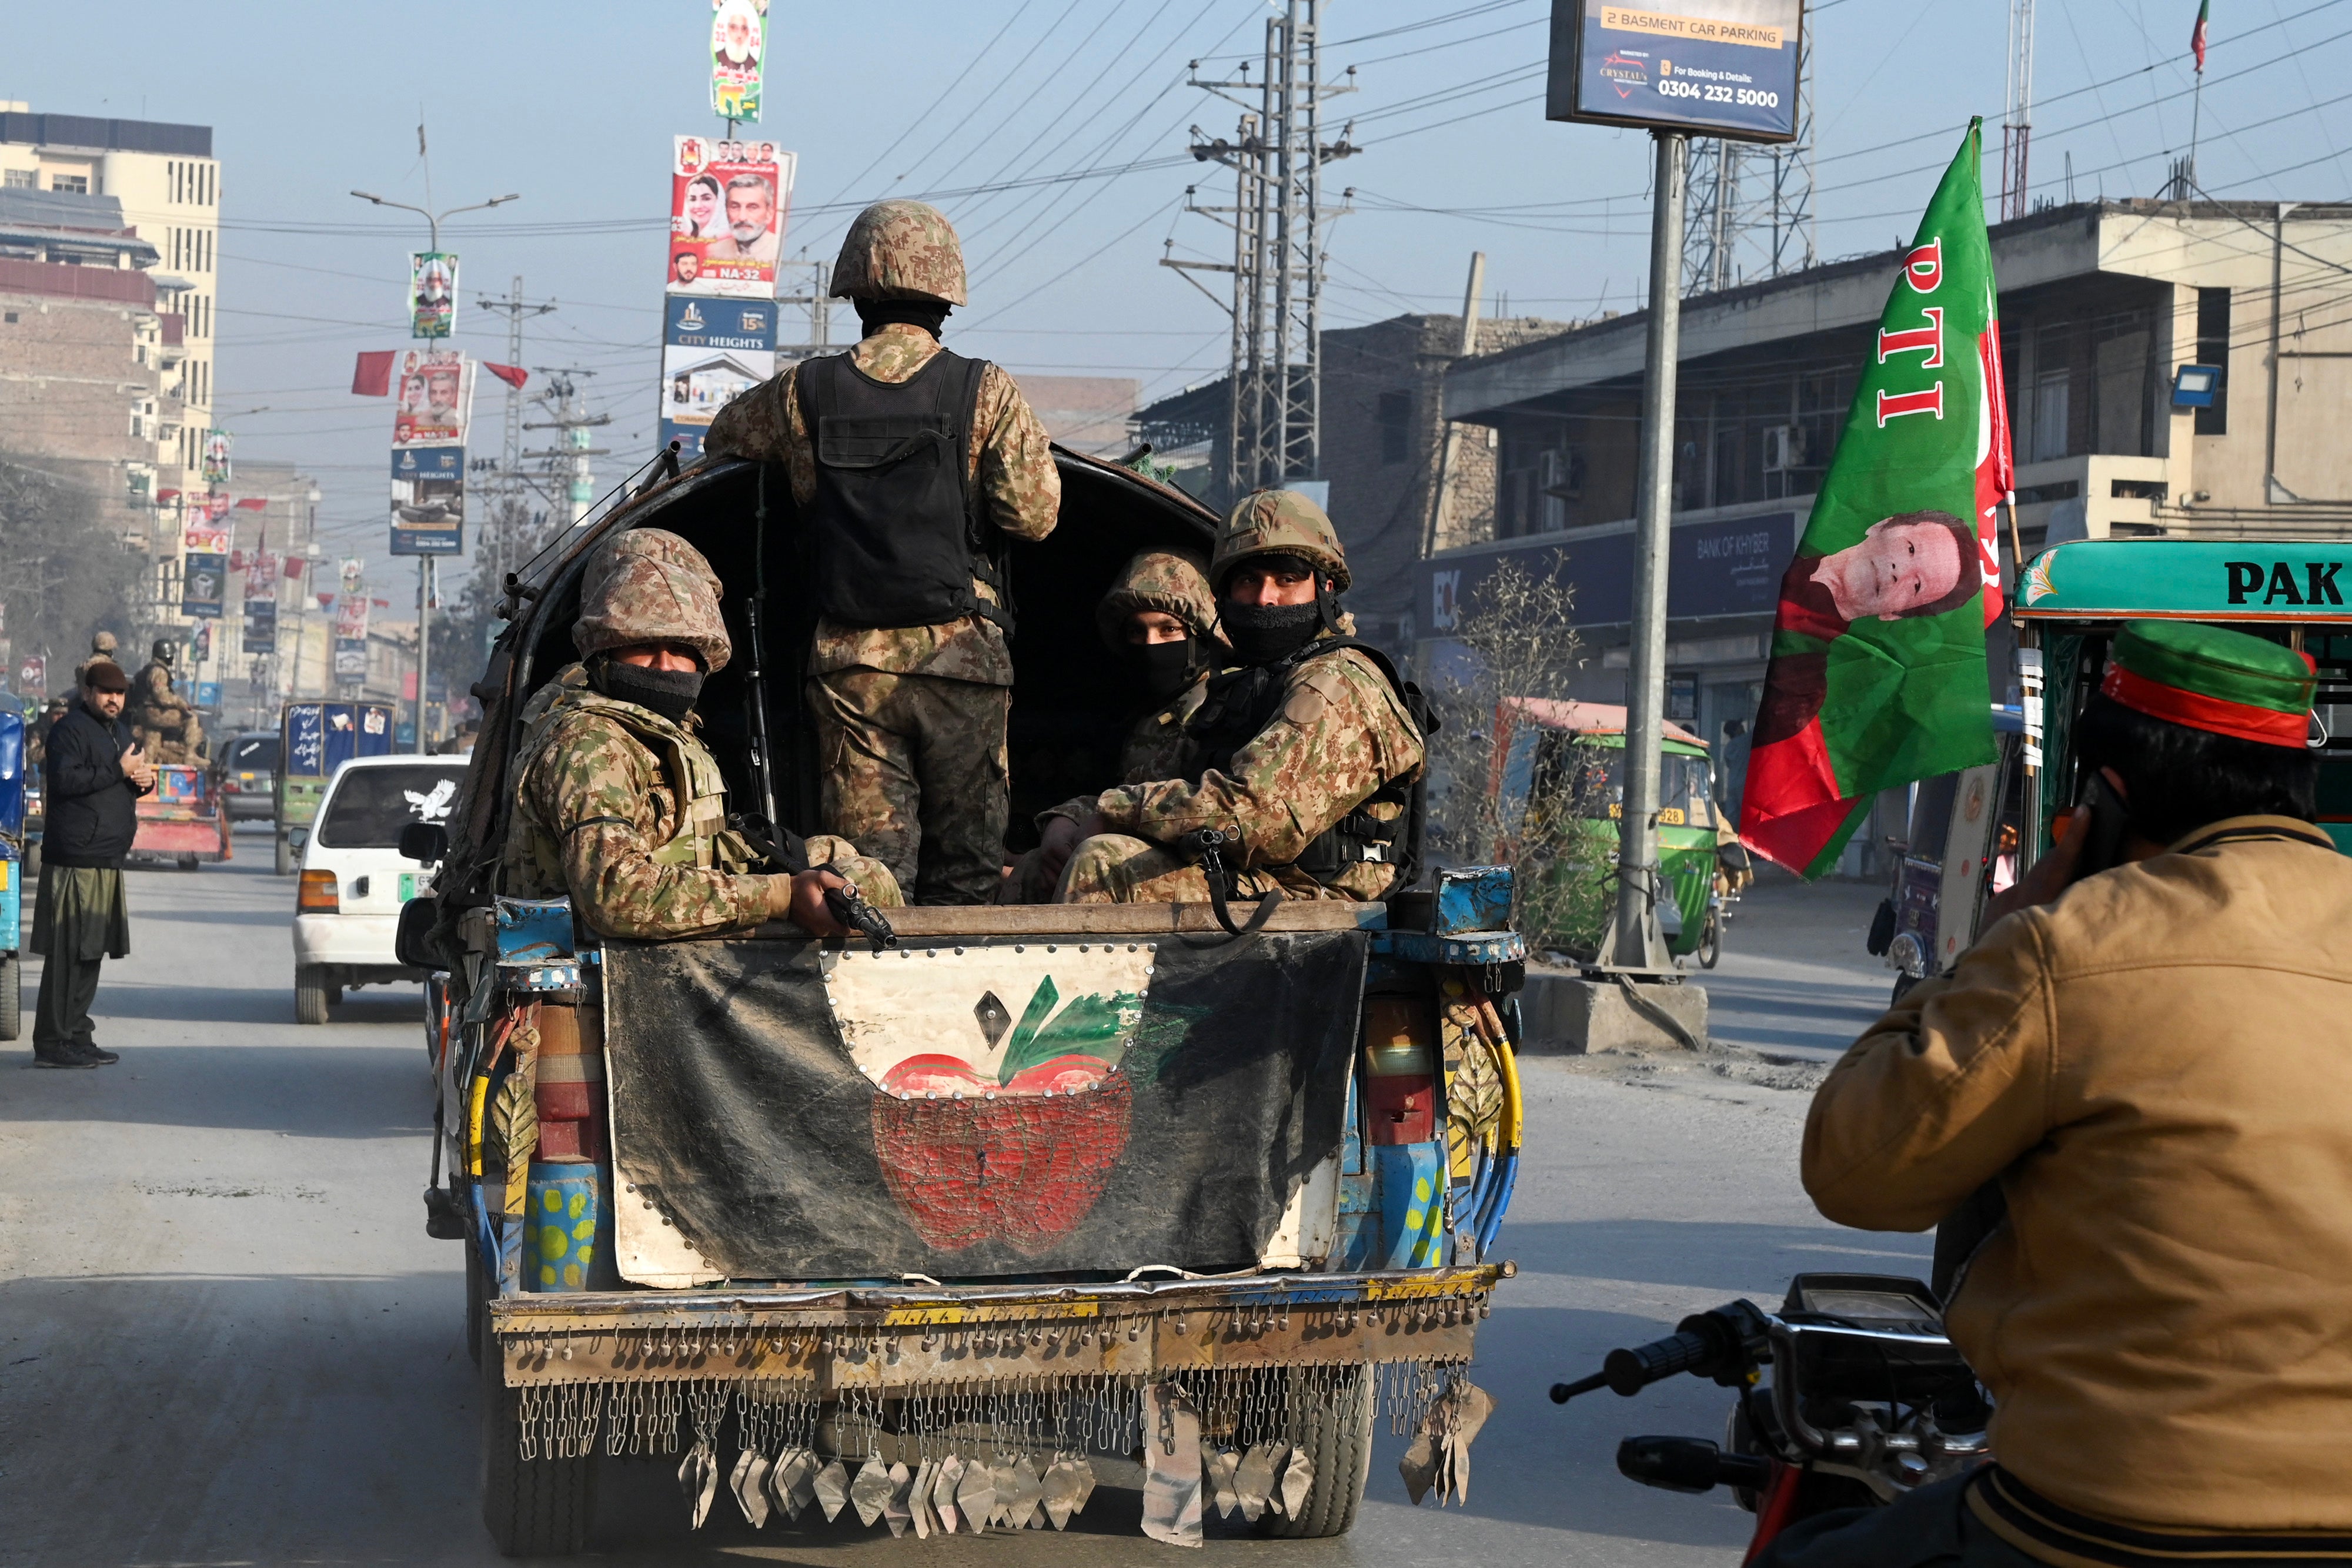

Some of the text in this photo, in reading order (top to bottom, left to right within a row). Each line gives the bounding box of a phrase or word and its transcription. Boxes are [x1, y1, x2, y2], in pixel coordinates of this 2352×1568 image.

[716, 31, 726, 42] 32
[1608, 12, 1776, 43] 2 BASMENT CAR PARKING
[1600, 68, 1648, 81] CRYSTAL's
[1675, 66, 1752, 83] For Booking & Details:
[1659, 79, 1778, 108] 0304 232 5000
[720, 268, 760, 280] NA-32
[679, 335, 764, 349] CITY HEIGHTS
[1876, 236, 1944, 429] PTI
[1698, 531, 1769, 559] BANK OF KHYBER
[2224, 561, 2344, 606] PAK
